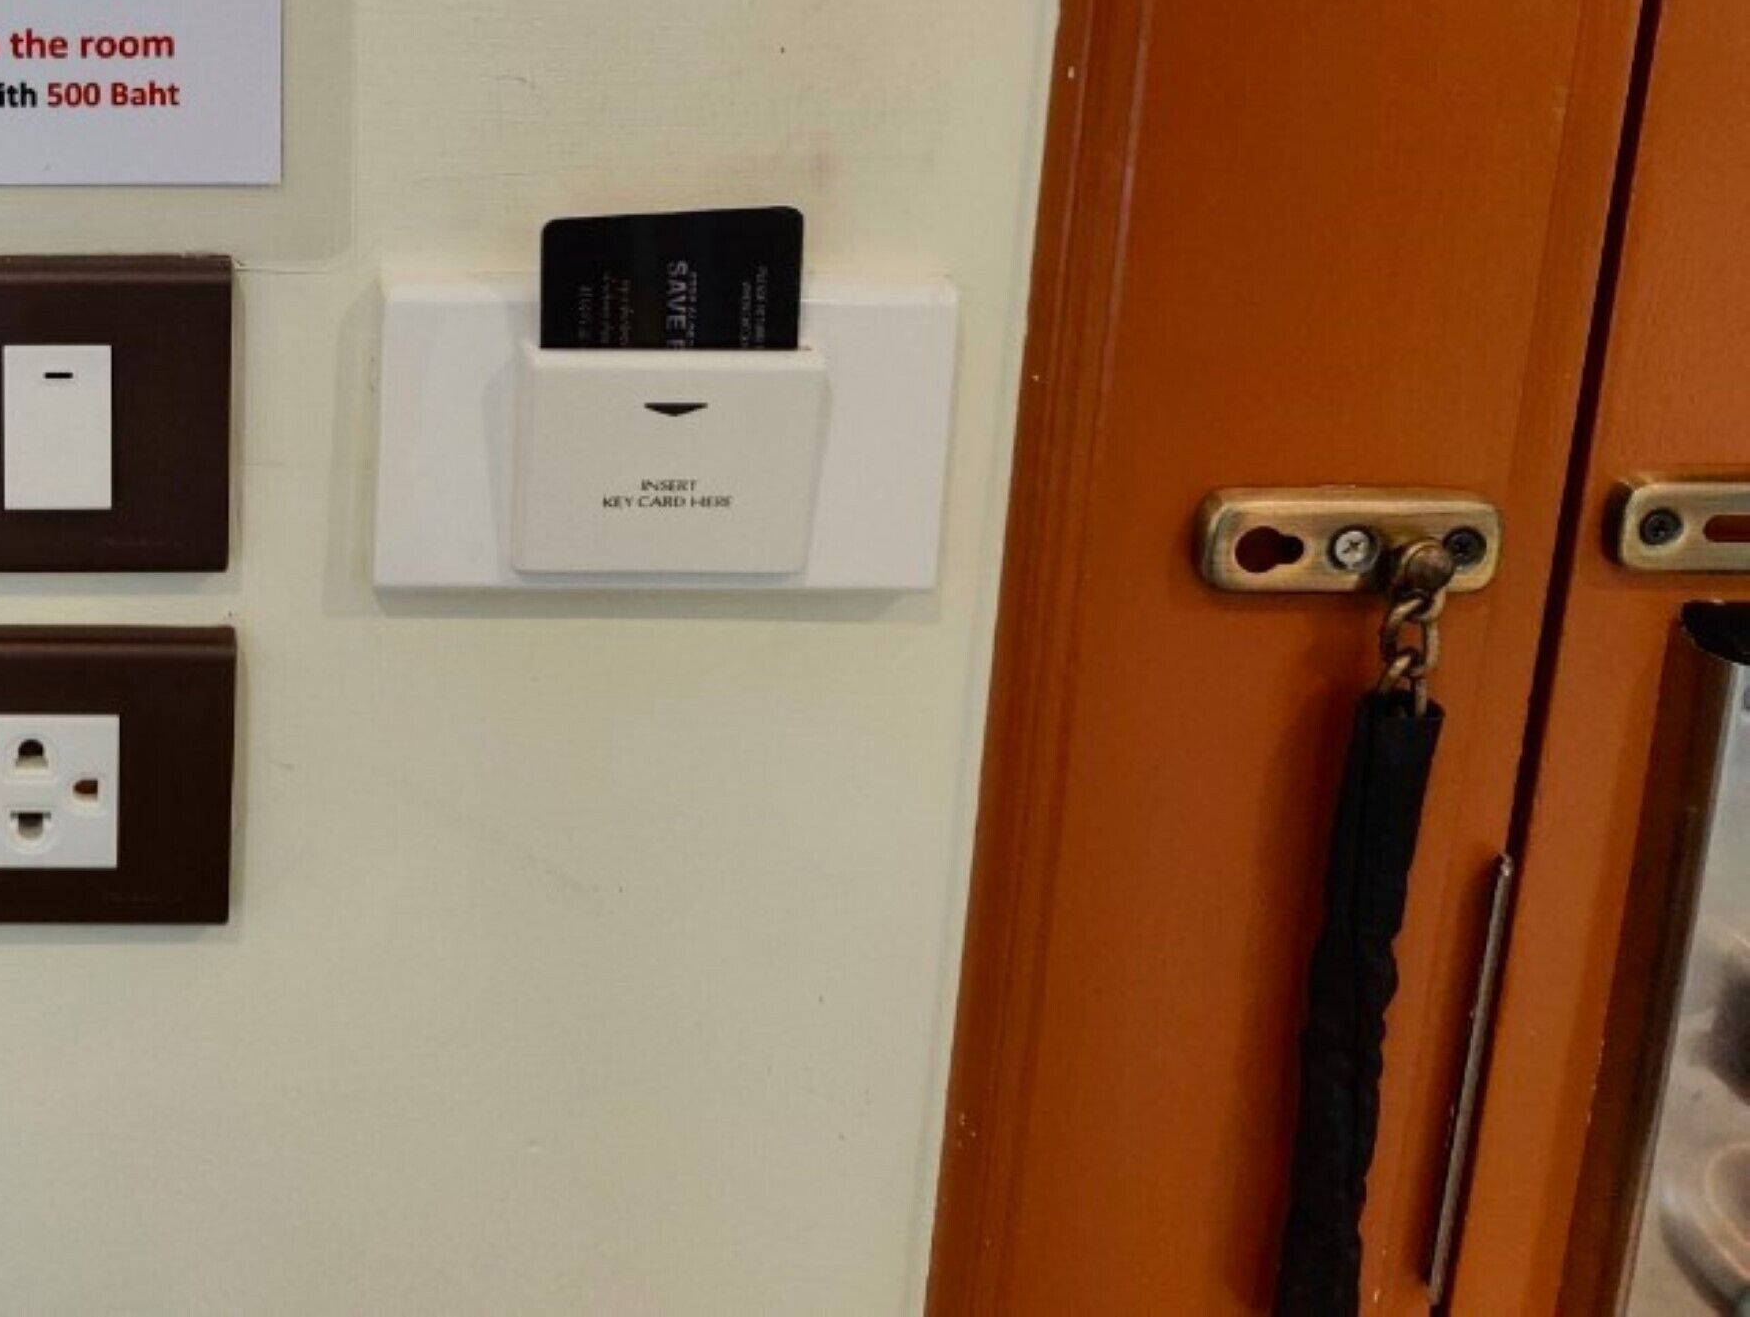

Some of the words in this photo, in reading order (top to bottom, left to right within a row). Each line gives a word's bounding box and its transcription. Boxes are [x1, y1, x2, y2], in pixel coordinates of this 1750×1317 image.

[10, 29, 69, 60] the
[80, 34, 175, 59] room
[47, 82, 101, 108] 500
[111, 81, 180, 106] Baht
[665, 260, 689, 331] SAVE
[640, 479, 698, 492] INSERT
[602, 496, 633, 509] KEY
[637, 495, 687, 508] CARD
[690, 495, 734, 508] HERE
